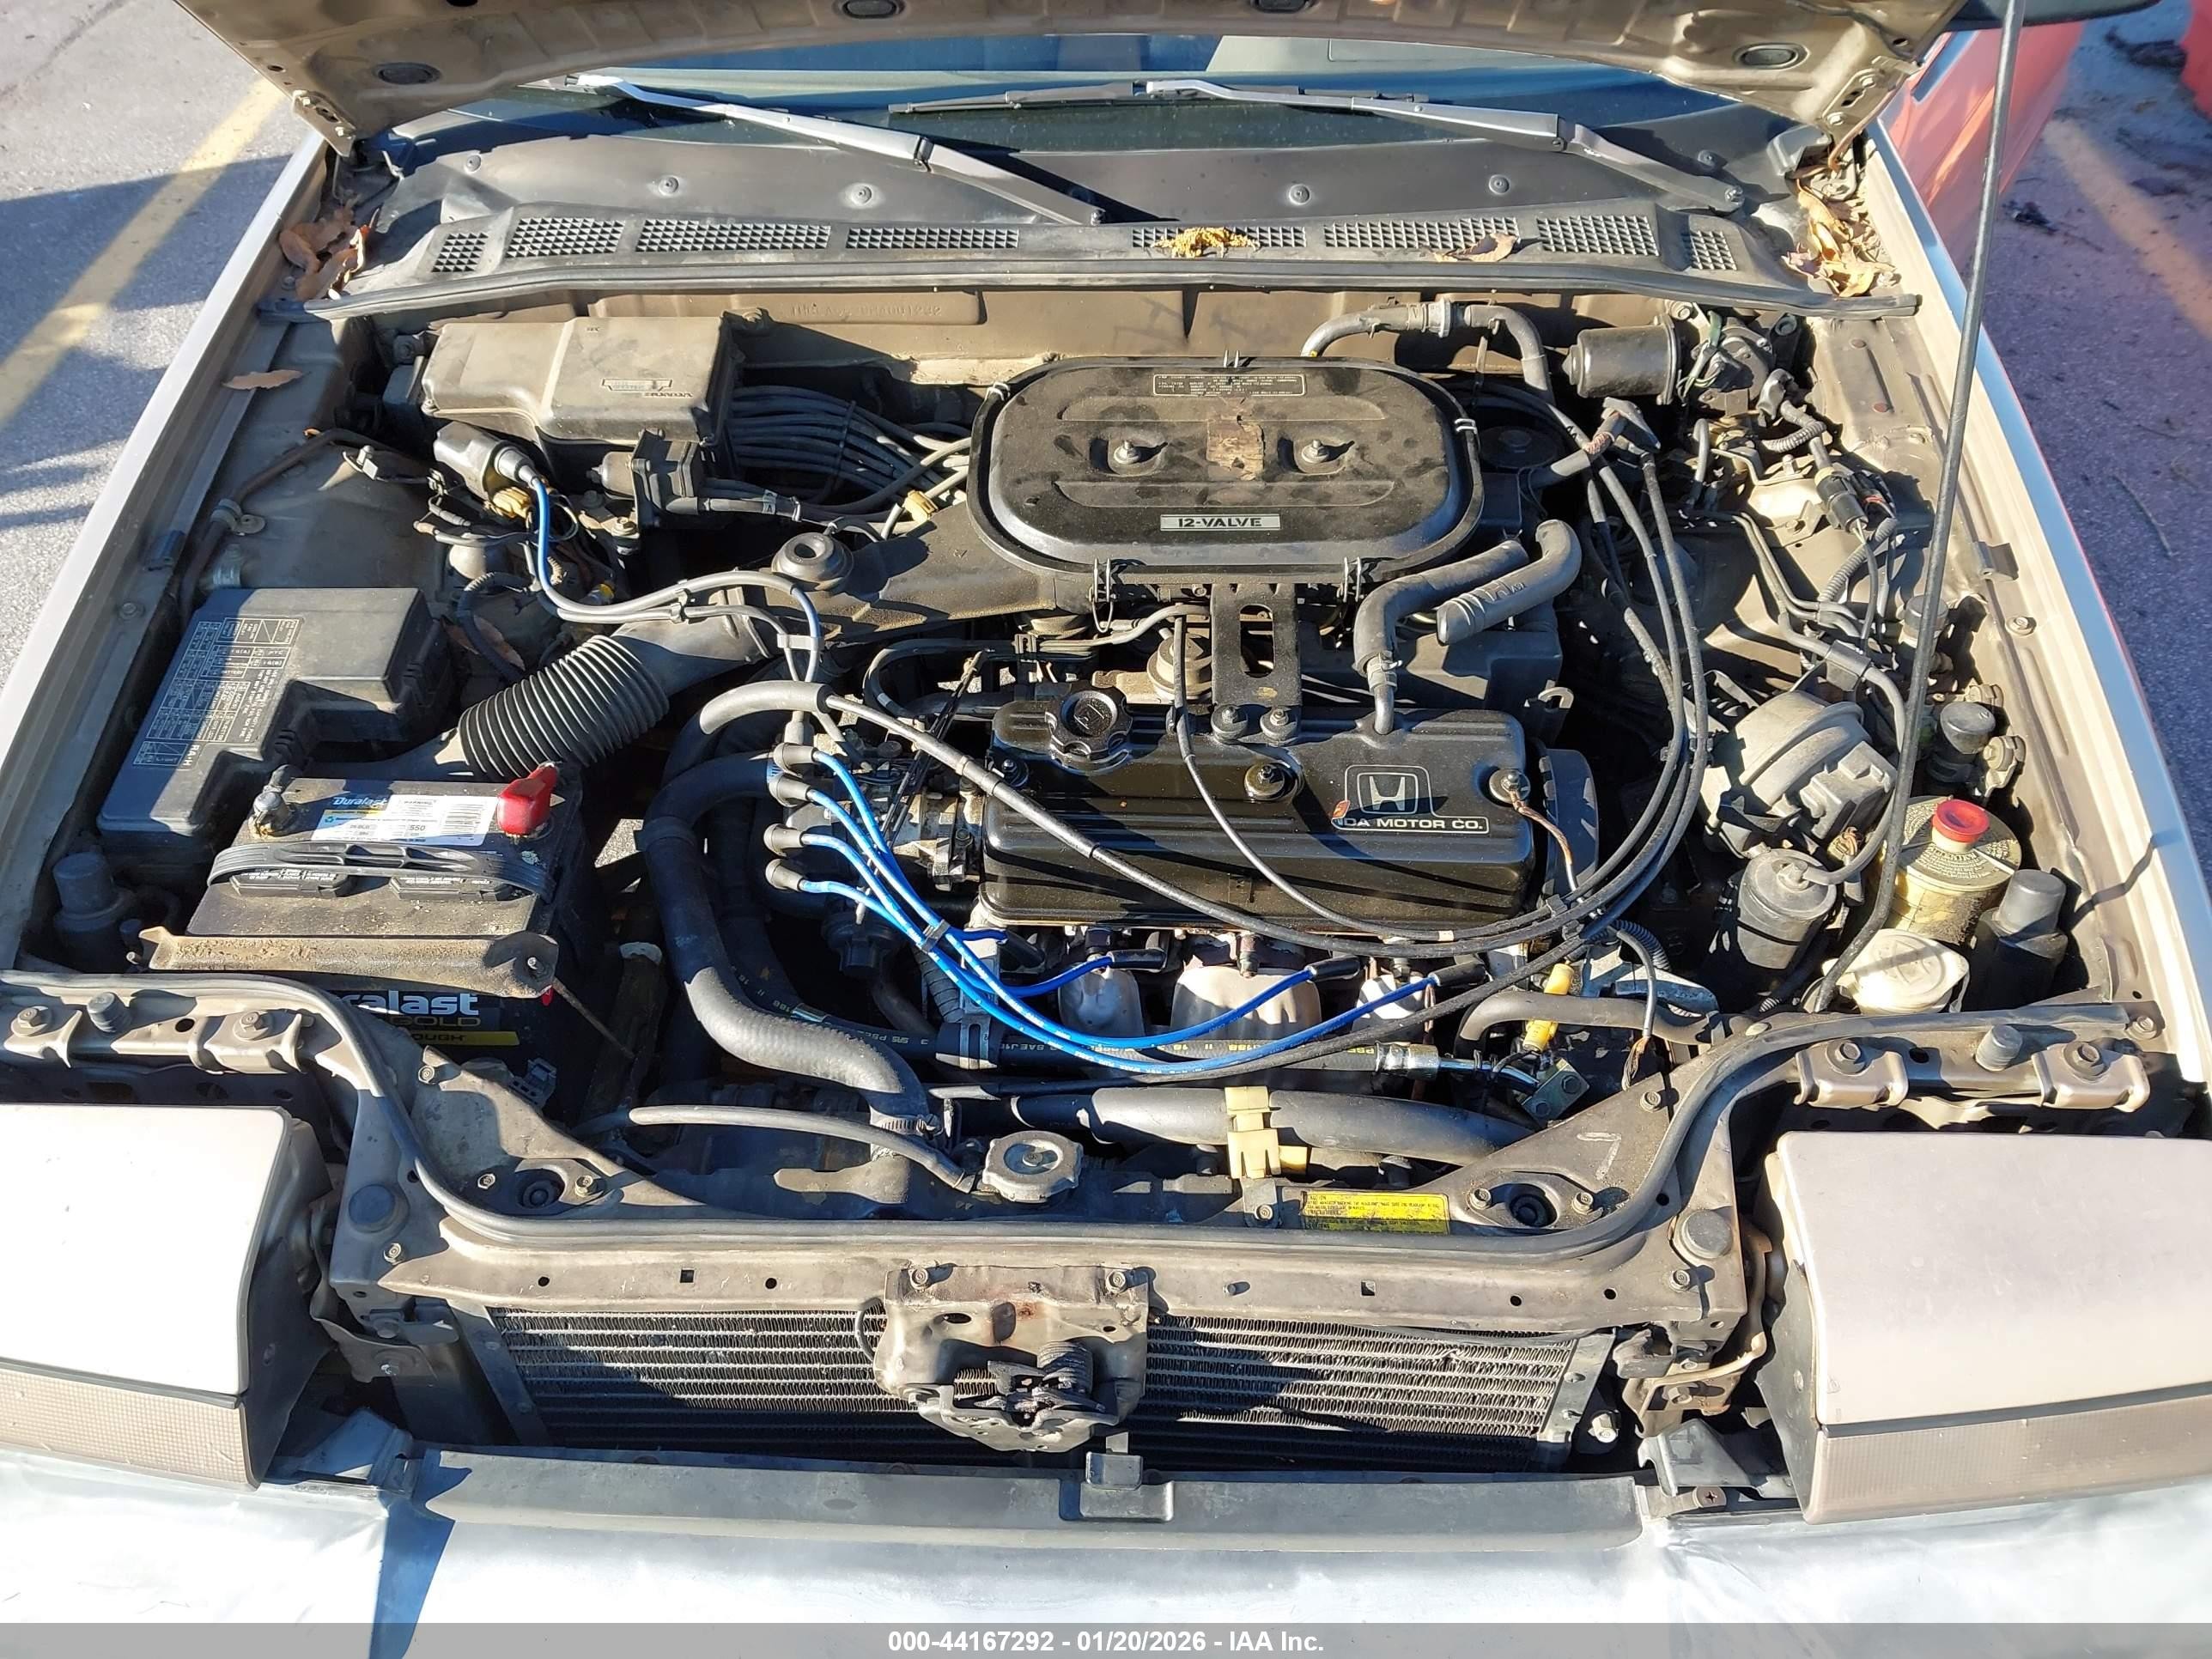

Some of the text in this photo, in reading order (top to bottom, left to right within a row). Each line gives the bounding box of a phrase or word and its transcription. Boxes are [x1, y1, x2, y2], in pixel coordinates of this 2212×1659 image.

[1177, 516, 1263, 529] 12-VALVE
[332, 797, 386, 806] Duralast
[1376, 818, 1445, 829] MOTOR
[1451, 818, 1484, 830] CO.
[341, 988, 480, 1017] ralast
[389, 1016, 482, 1027] GOLD
[410, 1033, 465, 1042] OUGH
